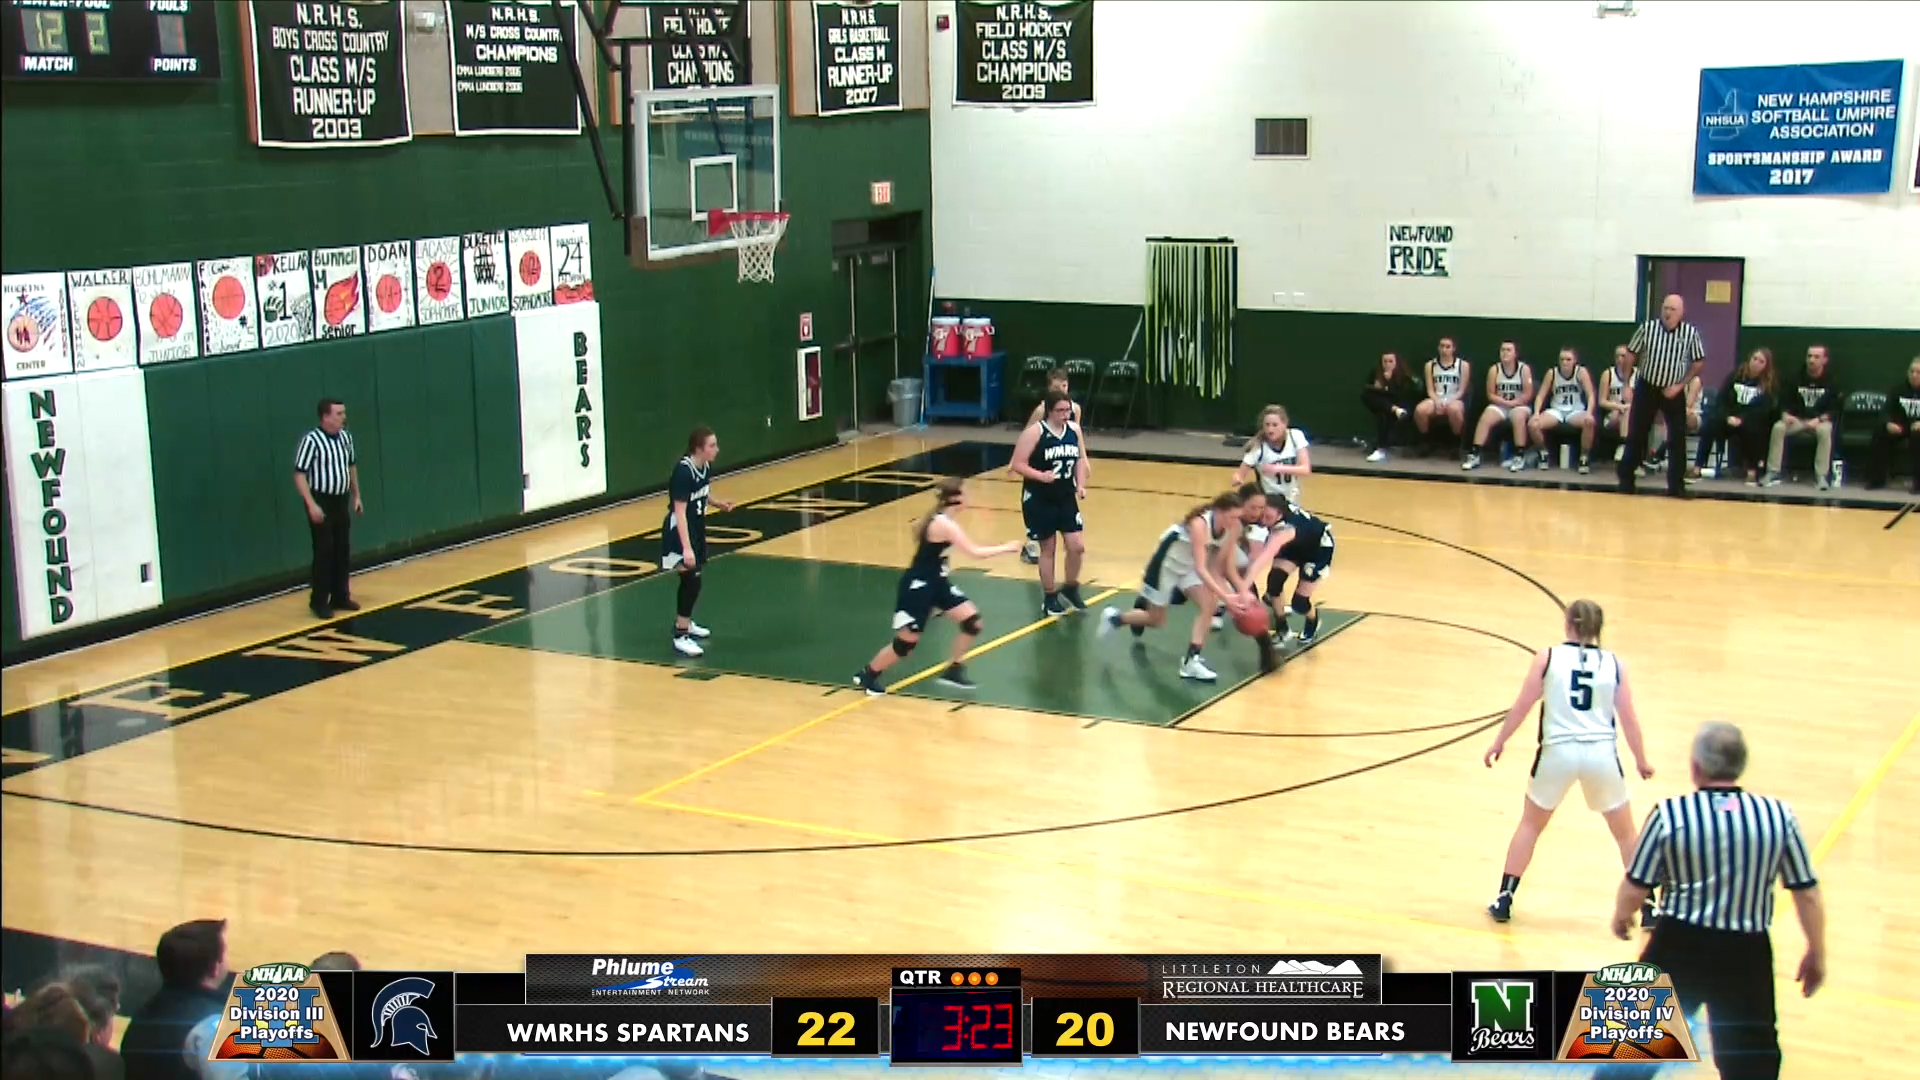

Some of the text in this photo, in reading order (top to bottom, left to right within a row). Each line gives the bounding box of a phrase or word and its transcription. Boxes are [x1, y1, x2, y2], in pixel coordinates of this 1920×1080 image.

[466, 24, 486, 40] M/S
[490, 25, 520, 39] CROSS
[828, 26, 890, 44] GIRLS BASKETBALL
[976, 20, 1072, 39] FIELD HOCKEY
[272, 26, 389, 53] BOYS CROSS COUNTRY
[476, 44, 557, 62] CHAMPIONS
[834, 45, 885, 63] CLASS M
[982, 39, 1066, 61] CLASS M/S
[24, 57, 73, 72] MATCH
[154, 58, 197, 72] POINTS
[290, 55, 376, 86] CLASS M/S
[976, 62, 1072, 82] CHAMPIONS
[827, 63, 893, 88] RUNNER-UP
[293, 87, 376, 115] RUNNER-UP
[845, 86, 877, 105] 2007
[1002, 84, 1046, 100] 2009
[1757, 88, 1892, 108] NEW HAMPSHIRE
[1706, 115, 1744, 126] NHSUA
[1751, 105, 1896, 124] SOFTBALL UMPIRE
[312, 118, 362, 139] 2003
[1769, 123, 1875, 140] ASSOCIATION
[1708, 149, 1883, 166] SPORTSMANSHIP AWARD
[1769, 168, 1815, 185] 2017
[1390, 225, 1453, 243] NEWFOUND
[368, 243, 408, 262] DOAN
[559, 242, 584, 276] 24
[1389, 246, 1447, 270] PRIDE
[71, 270, 129, 287] WALKER
[469, 296, 508, 314] JUNIOR
[265, 322, 300, 344] 2020
[149, 345, 192, 362] JUNIOR
[16, 360, 46, 370] CENTER
[573, 331, 592, 468] BEARS
[1052, 460, 1075, 479] 23
[29, 389, 74, 624] NEWFOUND
[1570, 670, 1594, 711] 5
